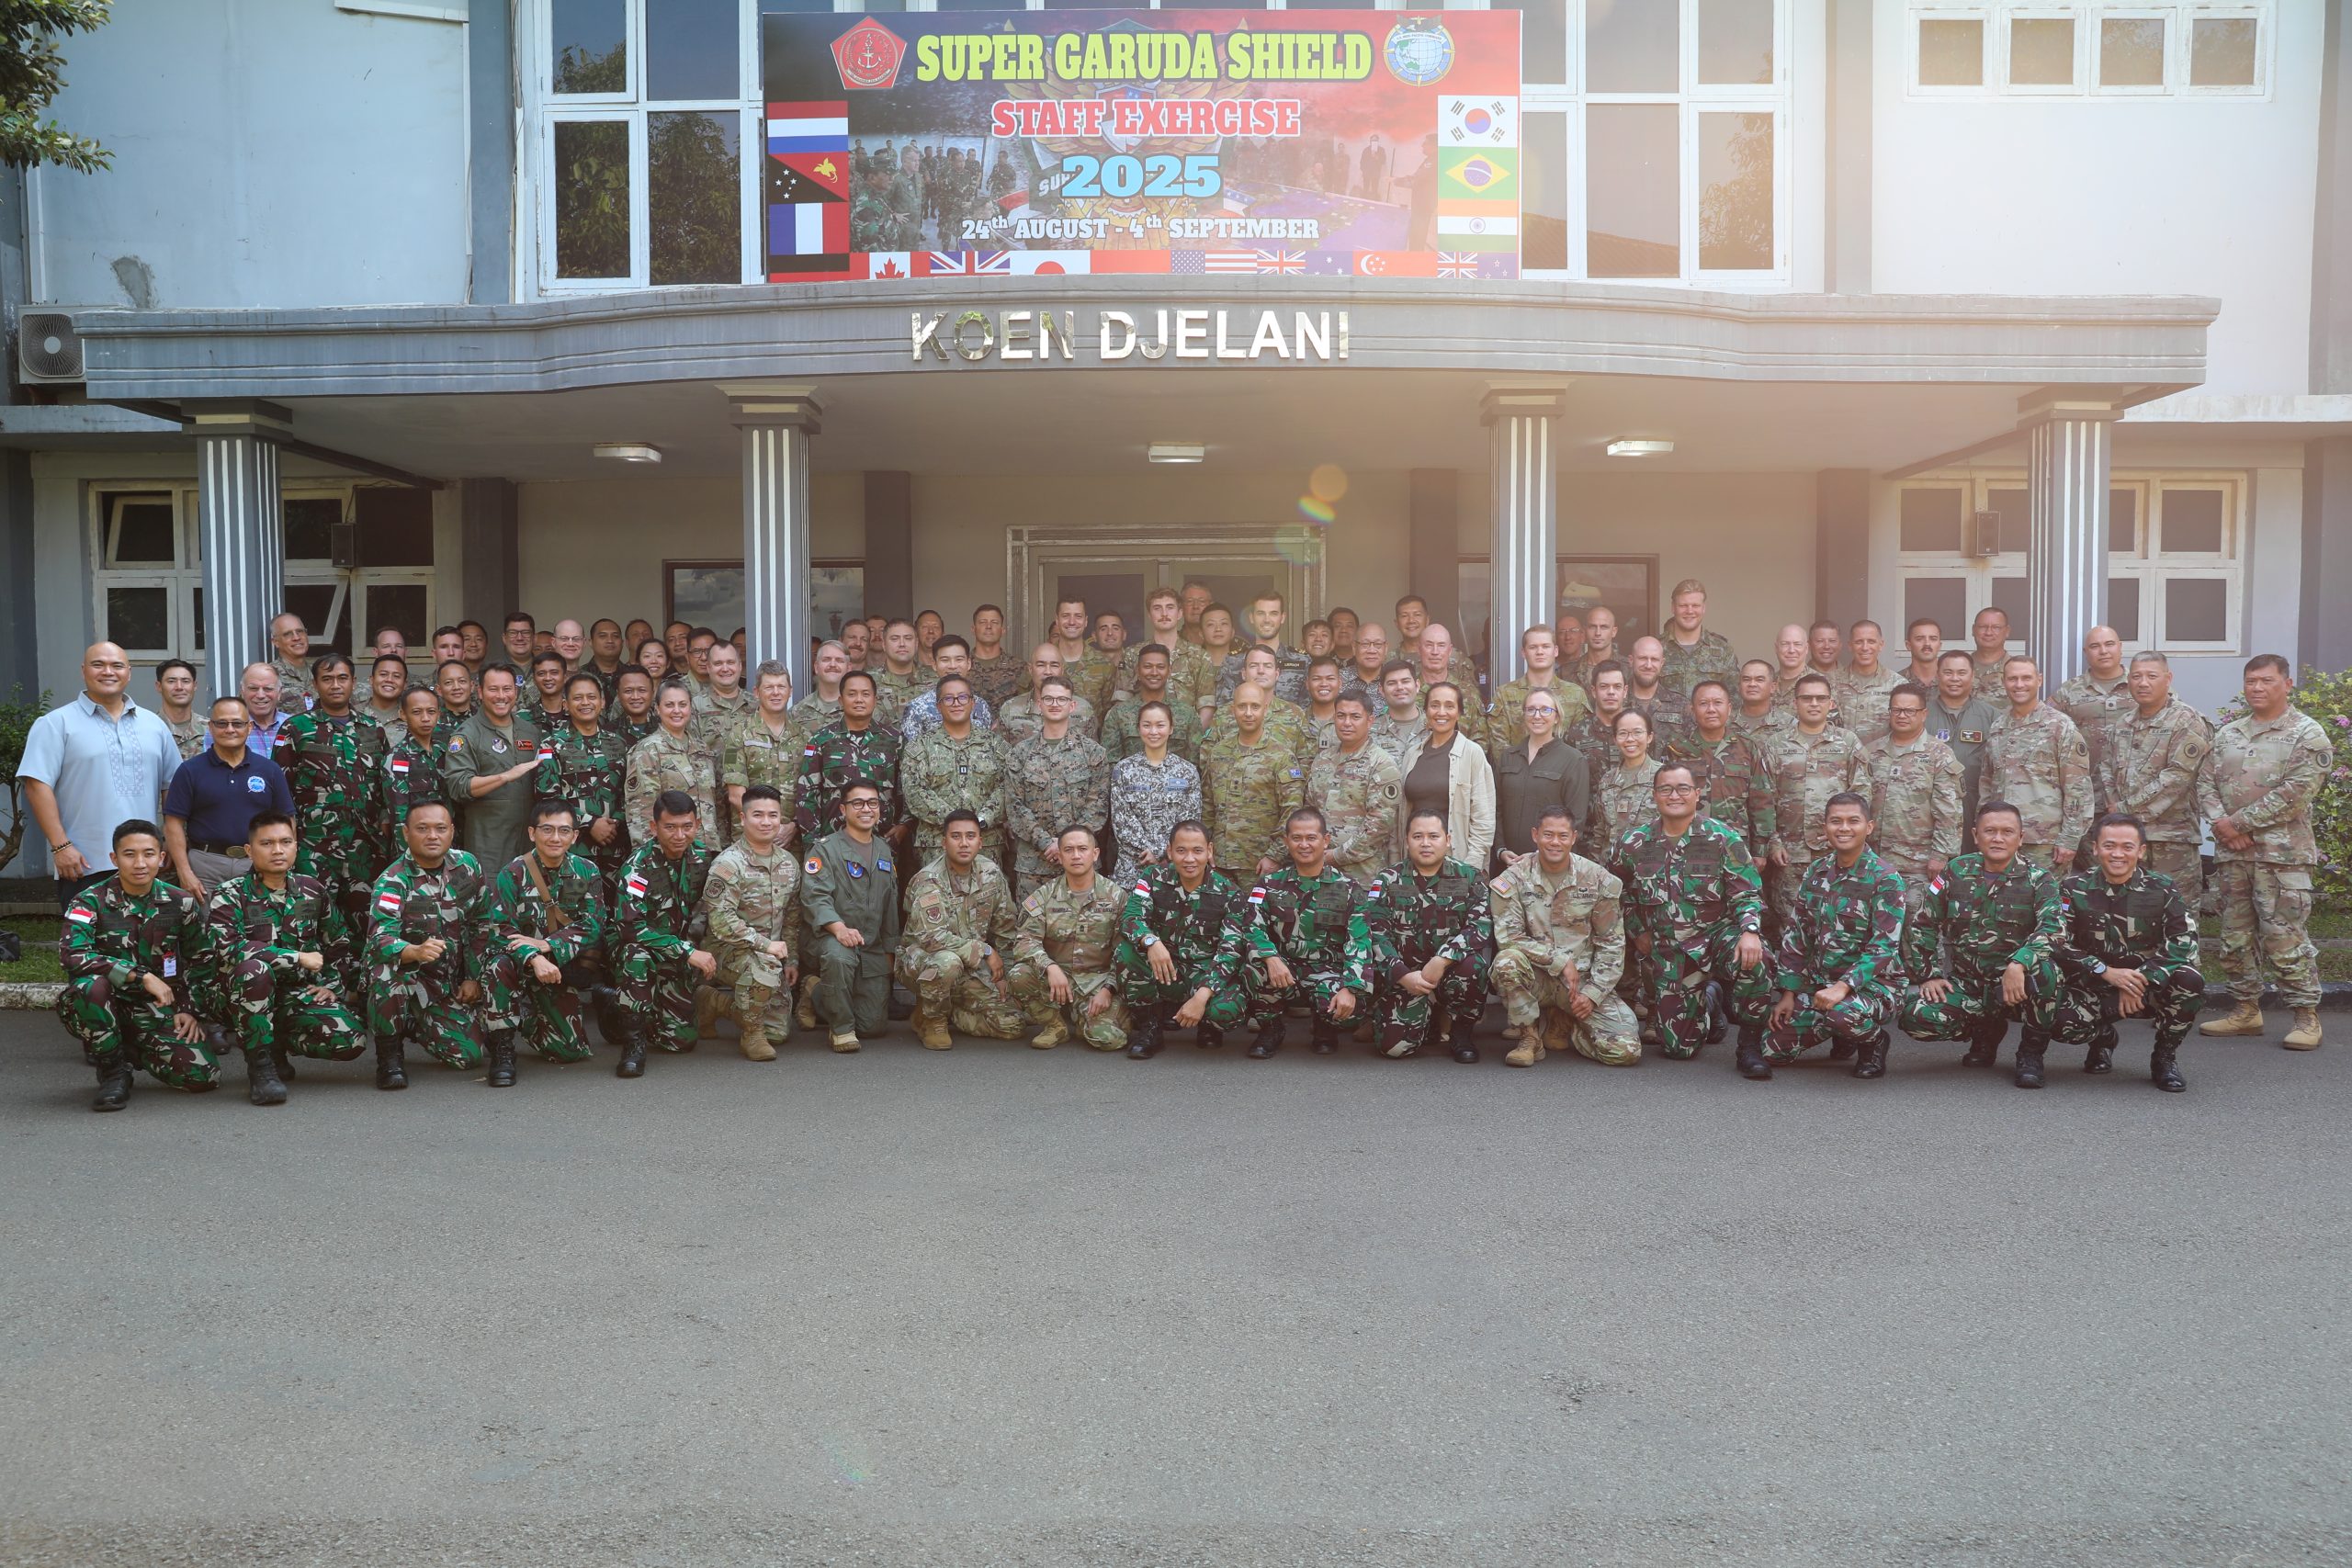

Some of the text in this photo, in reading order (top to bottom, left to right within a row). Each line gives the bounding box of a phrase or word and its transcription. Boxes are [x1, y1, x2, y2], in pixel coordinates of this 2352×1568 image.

[916, 32, 1372, 81] SUPER GARUDA SHIELD
[991, 98, 1302, 138] STAFF EXERCISE
[1061, 154, 1222, 197] 2025
[961, 216, 1009, 241] 24th
[1014, 218, 1111, 240] AUGUST
[1128, 214, 1162, 240] 4th
[1169, 217, 1320, 240] SEPTEMBER
[911, 309, 1350, 362] KOEN DJELANI
